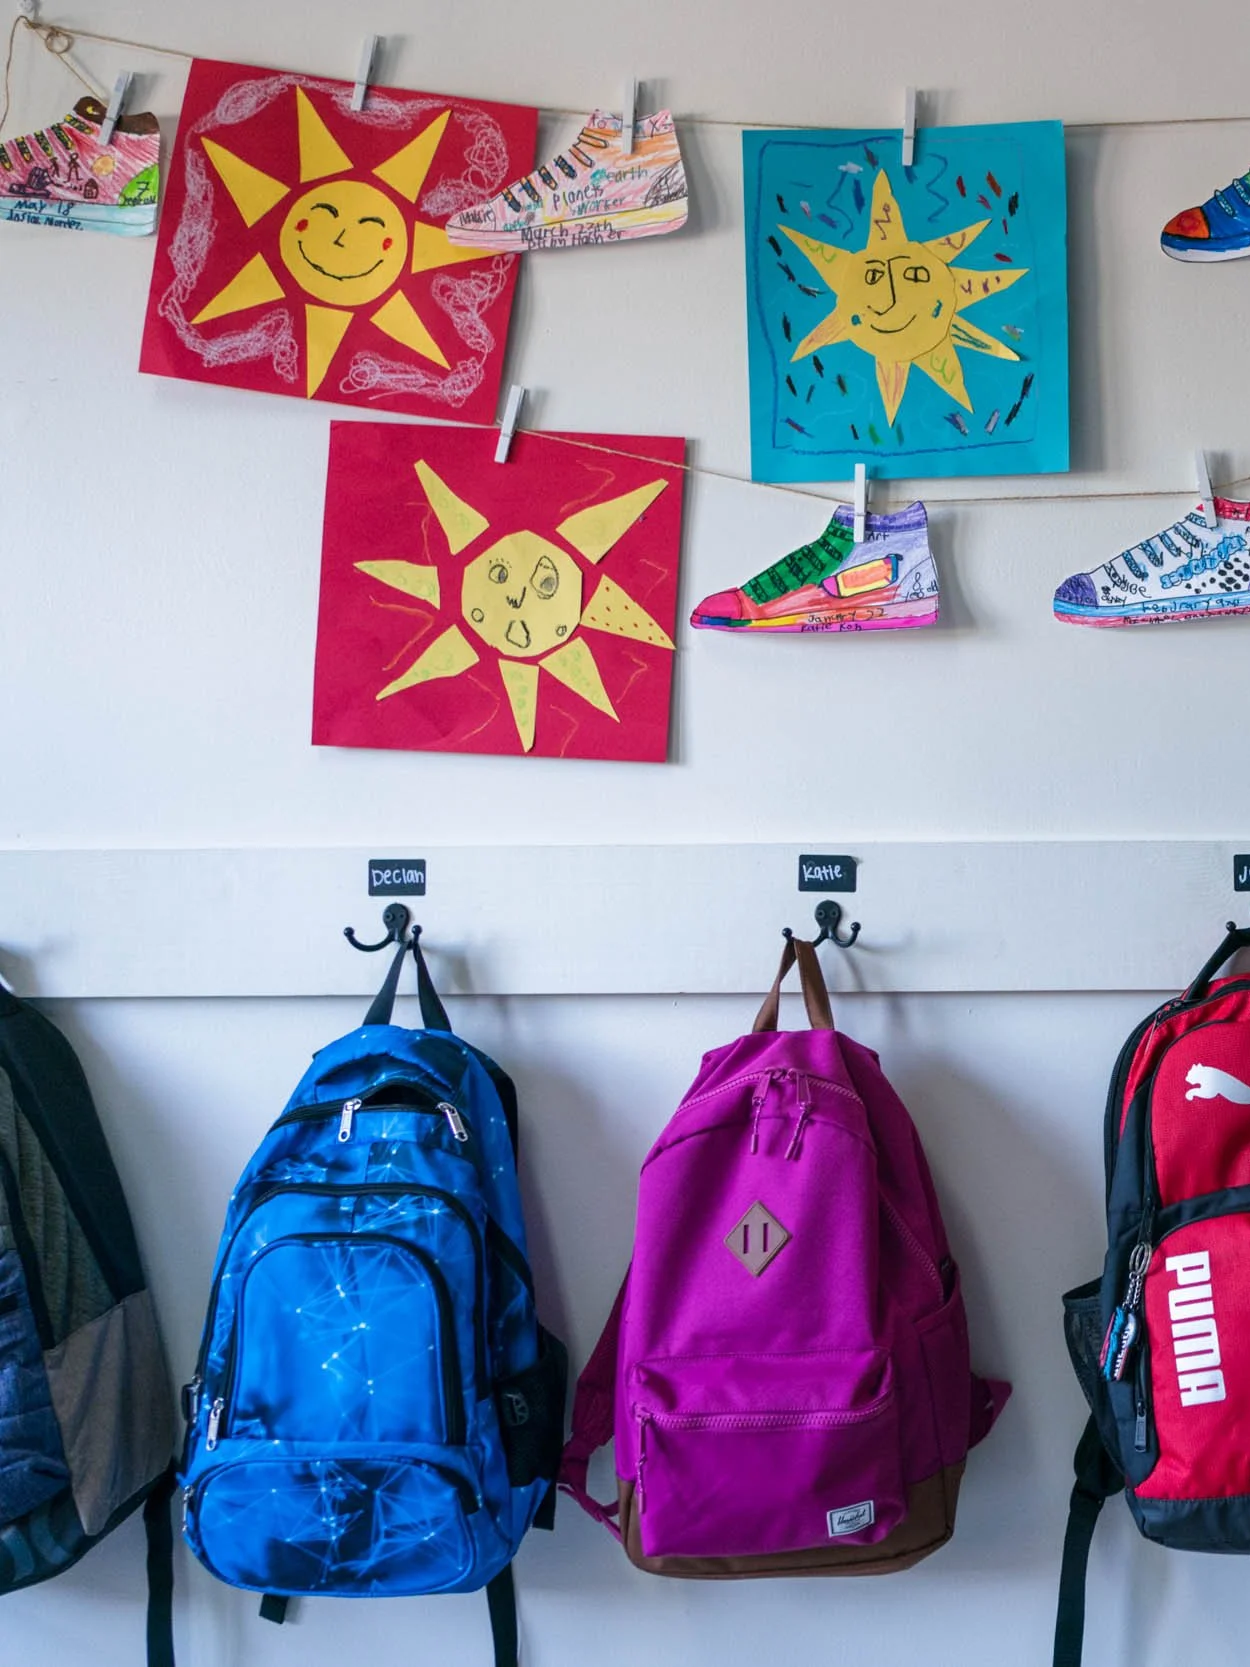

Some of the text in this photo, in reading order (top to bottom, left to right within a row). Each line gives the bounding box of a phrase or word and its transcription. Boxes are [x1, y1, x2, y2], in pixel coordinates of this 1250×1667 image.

[14, 200, 47, 214] May
[912, 571, 921, 592] 8
[371, 867, 425, 888] Declan
[802, 864, 843, 882] Katie
[1165, 1250, 1226, 1408] PUMA
